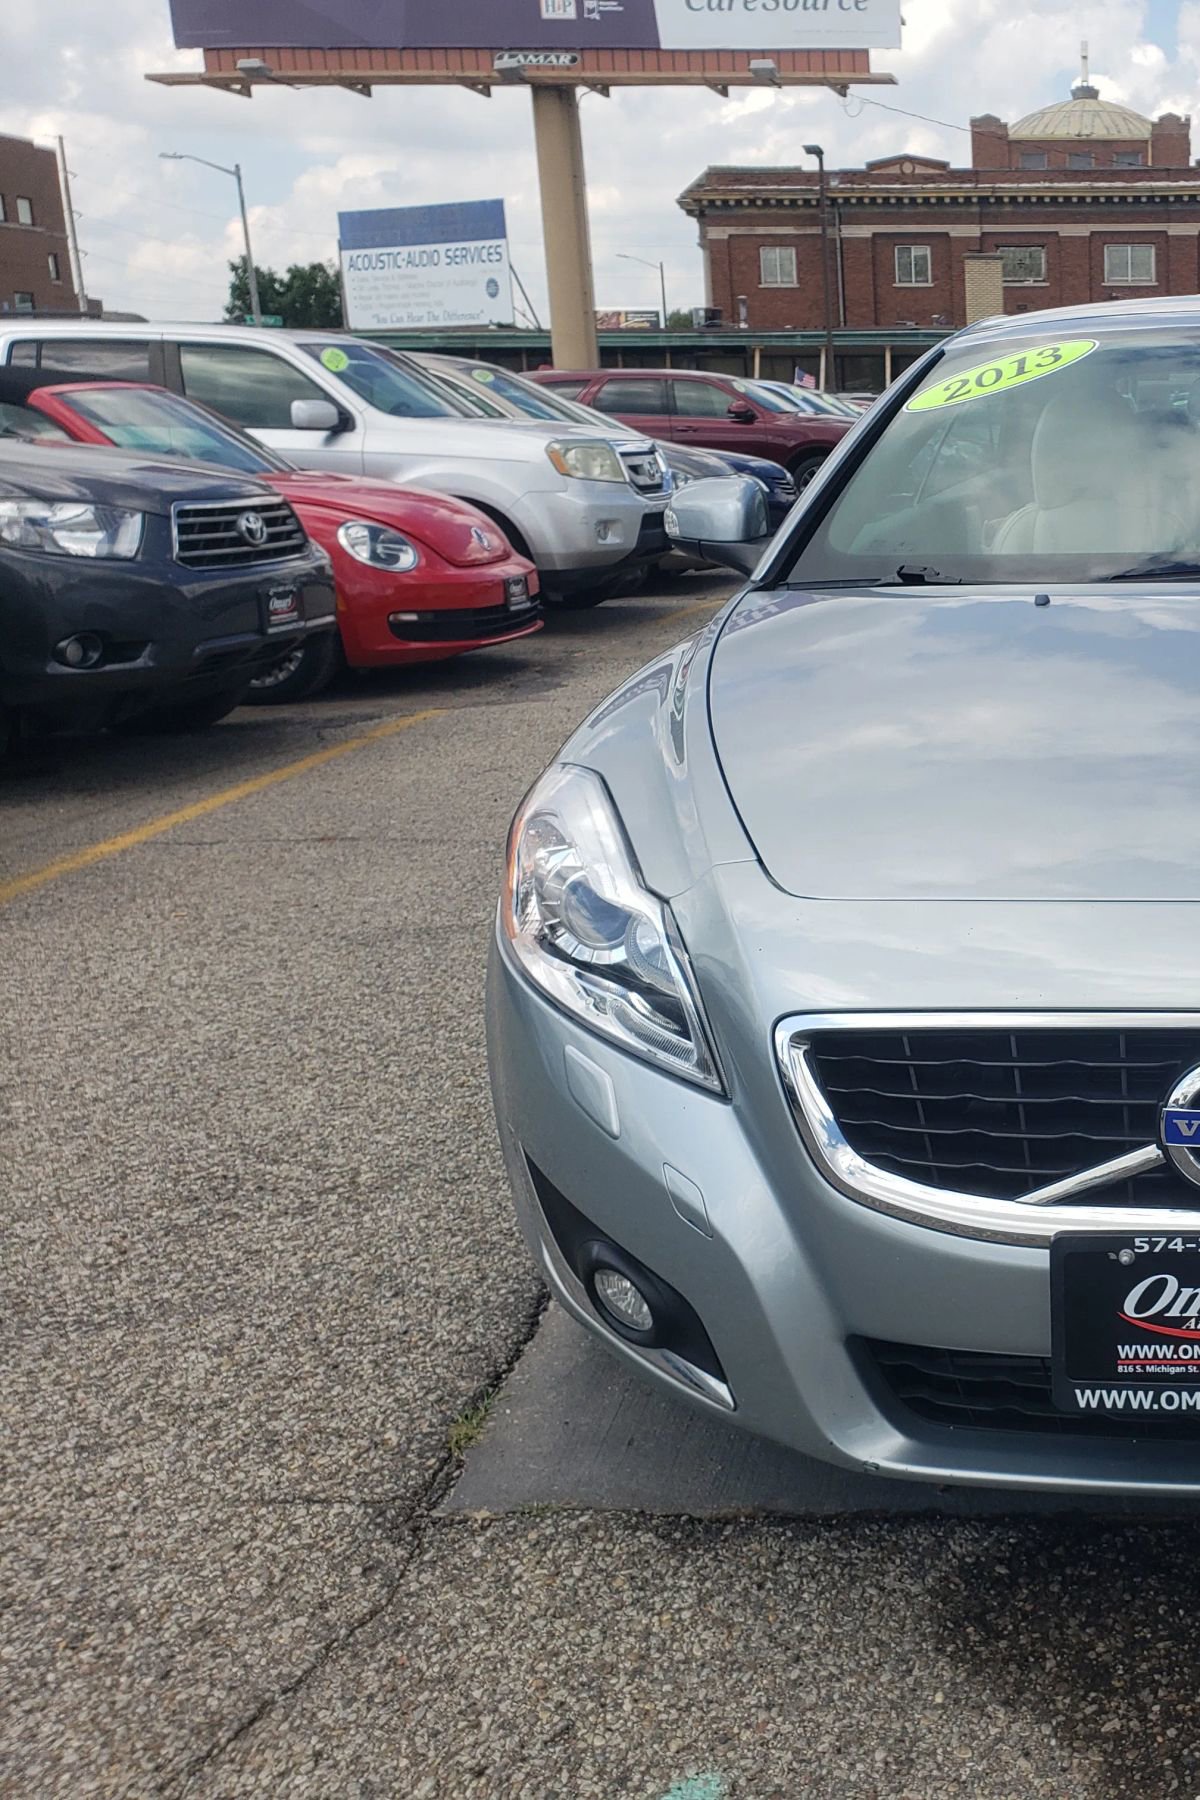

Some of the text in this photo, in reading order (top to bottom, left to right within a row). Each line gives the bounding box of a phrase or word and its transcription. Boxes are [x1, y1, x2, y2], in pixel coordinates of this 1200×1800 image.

[445, 244, 503, 266] SERVICES
[943, 346, 1063, 403] 2013
[1117, 1365, 1134, 1373] 816
[1135, 1365, 1144, 1373] S.
[1146, 1364, 1186, 1375] Michigan
[1187, 1365, 1199, 1373] St.
